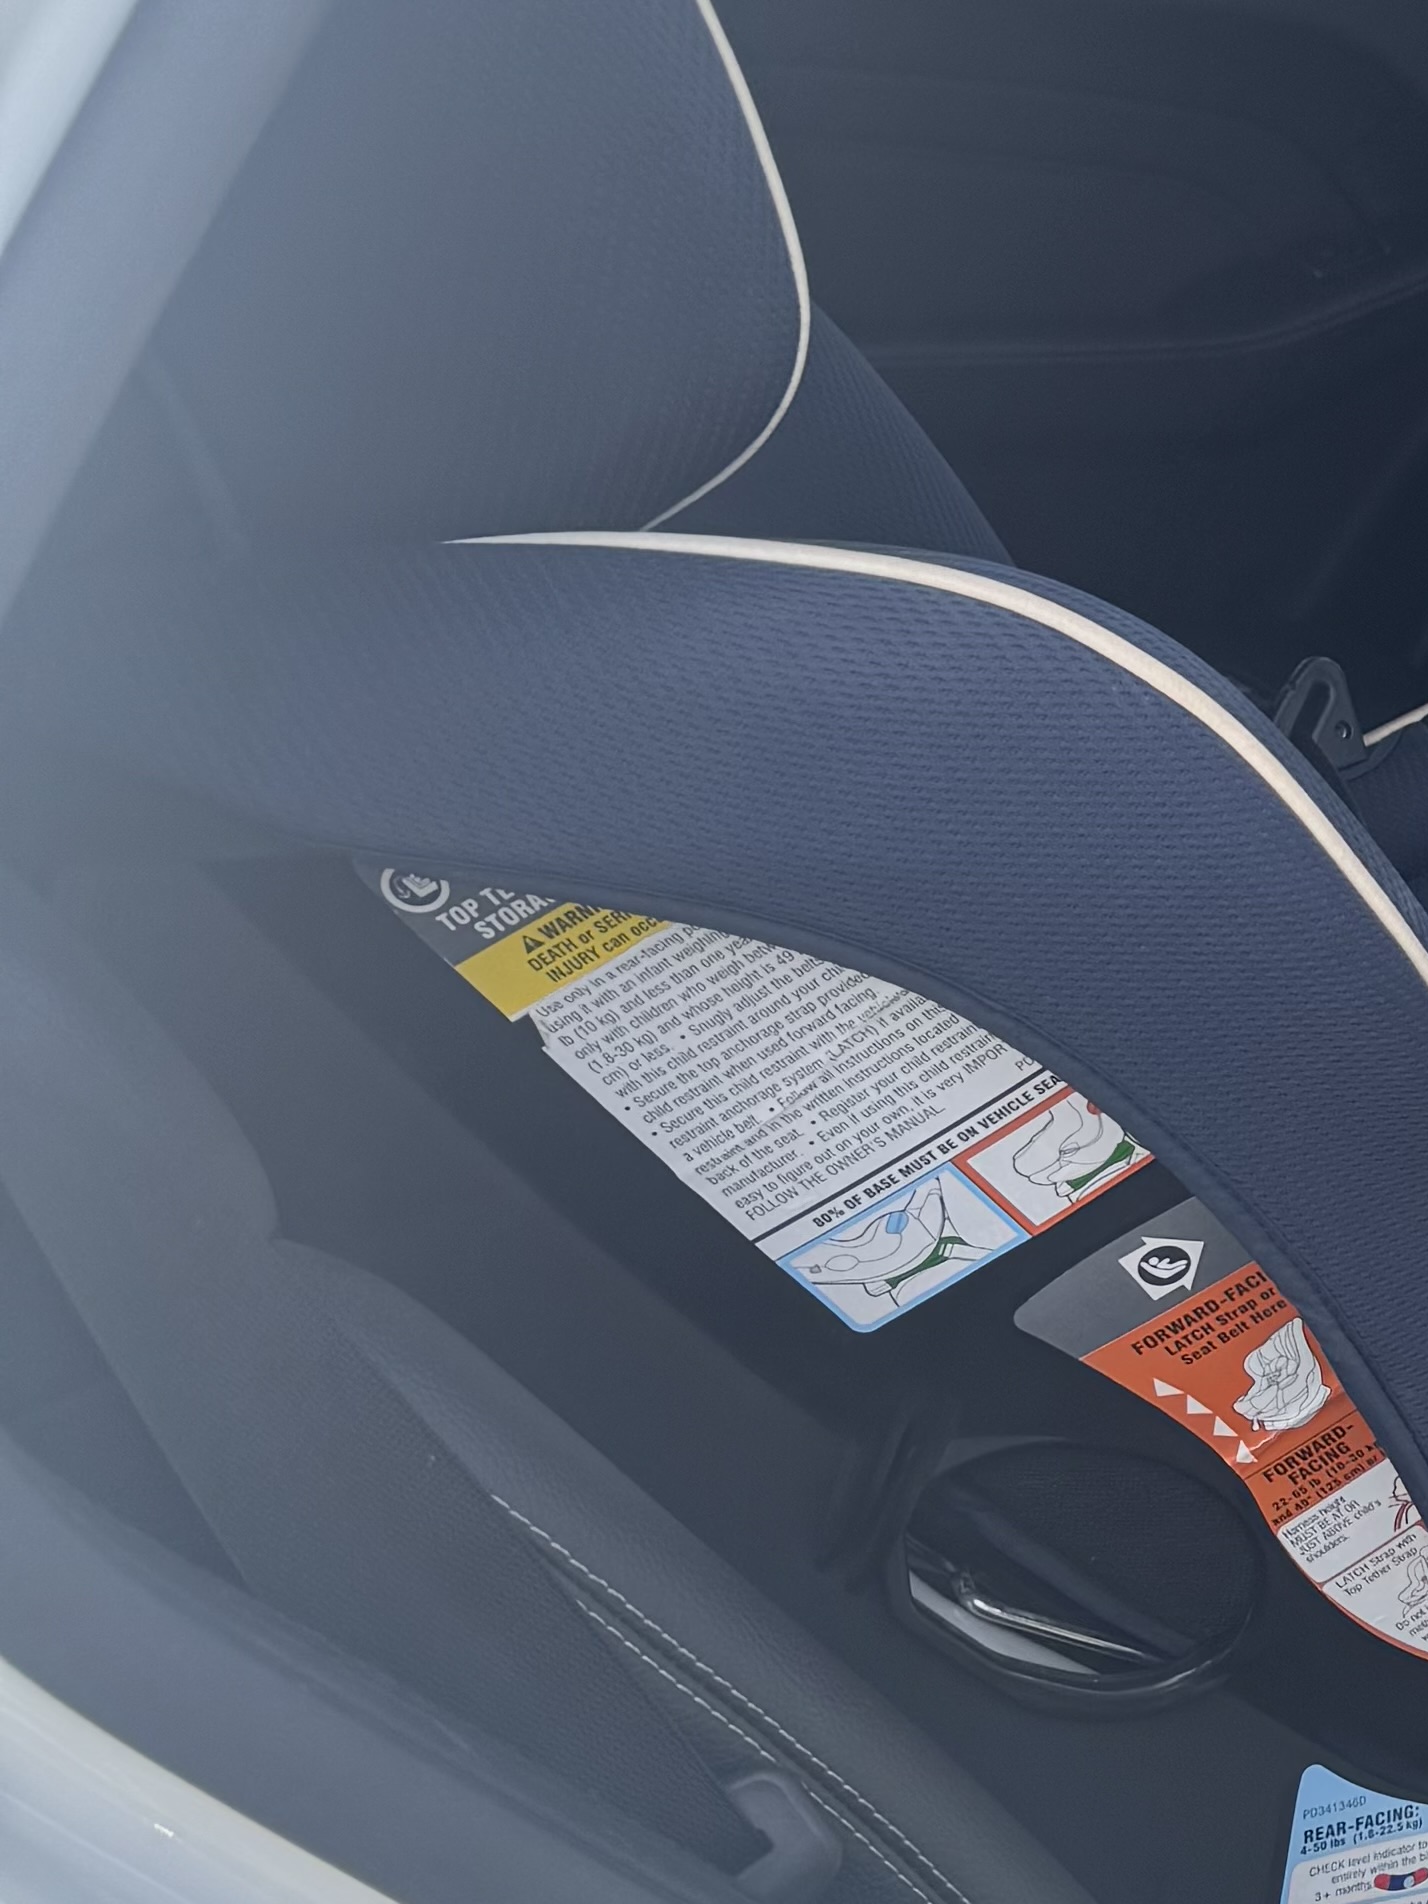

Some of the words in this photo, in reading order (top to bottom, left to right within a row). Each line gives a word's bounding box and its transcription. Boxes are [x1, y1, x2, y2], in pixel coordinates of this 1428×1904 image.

[434, 896, 485, 934] TOP
[472, 884, 556, 940] STORA
[536, 897, 602, 942] WARN
[526, 936, 579, 972] DEATH
[577, 929, 596, 944] or
[545, 944, 602, 983] INJURY
[600, 931, 630, 952] can
[571, 1038, 605, 1062] only
[599, 1024, 630, 1045] with
[626, 996, 678, 1029] children
[676, 980, 707, 1001] who
[703, 957, 747, 987] weigh
[585, 1040, 637, 1074] (1.8-30
[632, 1028, 659, 1048] kg)
[654, 1015, 682, 1035] and
[680, 992, 724, 1020] whose
[720, 968, 765, 998] height
[759, 960, 777, 974] is
[772, 949, 796, 966] 49
[598, 1064, 630, 1087] cm)
[627, 1058, 644, 1071] or
[687, 1005, 735, 1038] Snugly
[729, 983, 774, 1013] adjust
[768, 971, 794, 989] the
[612, 1077, 643, 1098] with
[639, 1064, 667, 1083] this
[662, 1046, 698, 1070] child
[694, 1019, 748, 1053] restraint
[744, 994, 792, 1024] around
[789, 978, 823, 1001] your
[632, 1078, 678, 1108] Secure
[674, 1066, 699, 1084] the
[696, 1054, 724, 1075] top
[718, 1018, 787, 1062] anchorage
[781, 999, 819, 1025] strap
[639, 1100, 673, 1123] child
[671, 1074, 722, 1106] restraint
[720, 1055, 756, 1079] when
[754, 1036, 789, 1060] used
[785, 1008, 837, 1042] forward
[705, 1162, 739, 1185] back
[736, 1154, 753, 1167] of
[750, 1142, 774, 1160] the
[817, 1086, 874, 1123] Register
[868, 1070, 903, 1094] your
[896, 1050, 933, 1075] child
[815, 1118, 850, 1142] Even
[846, 1112, 860, 1124] if
[857, 1092, 897, 1119] using
[891, 1077, 920, 1097] this
[915, 1059, 951, 1083] child
[732, 1187, 767, 1211] easy
[761, 1179, 780, 1193] to
[775, 1158, 816, 1186] figure
[811, 1147, 836, 1165] out
[833, 1138, 853, 1152] on
[851, 1121, 884, 1144] your
[910, 1094, 924, 1106] it
[920, 1087, 937, 1100] is
[934, 1070, 967, 1094] very
[812, 1203, 845, 1229] 80%
[843, 1192, 864, 1211] OF
[864, 1171, 900, 1199] BASE
[899, 1149, 937, 1178] MUST
[937, 1136, 958, 1156] BE
[957, 1123, 979, 1143] ON
[977, 1090, 1034, 1131] VEHICLE
[743, 1184, 801, 1221] FOLLOW
[796, 1169, 828, 1191] THE
[822, 1135, 888, 1177] OWNER'S
[1163, 1320, 1215, 1357] LATCH
[1215, 1296, 1258, 1327] Strap
[1259, 1285, 1277, 1301] or
[1179, 1338, 1217, 1366] Seat
[1216, 1319, 1249, 1344] Belt
[1249, 1296, 1288, 1324] Here
[1263, 1419, 1355, 1483] FORWARD-
[1288, 1440, 1350, 1485] FACING
[1300, 1840, 1327, 1856] 4-50
[1330, 1836, 1345, 1849] lbs
[1405, 1818, 1423, 1832] kg)
[1303, 1804, 1419, 1844] REAR-FACING:
[1309, 1857, 1344, 1877] CHECK
[1348, 1852, 1370, 1867] level
[1373, 1841, 1415, 1861] indicator
[1418, 1839, 1428, 1850] to
[1314, 1889, 1329, 1902] 3+
[1335, 1879, 1371, 1897] months
[1331, 1866, 1366, 1885] entirely
[1370, 1858, 1398, 1875] within
[1401, 1854, 1416, 1867] the
